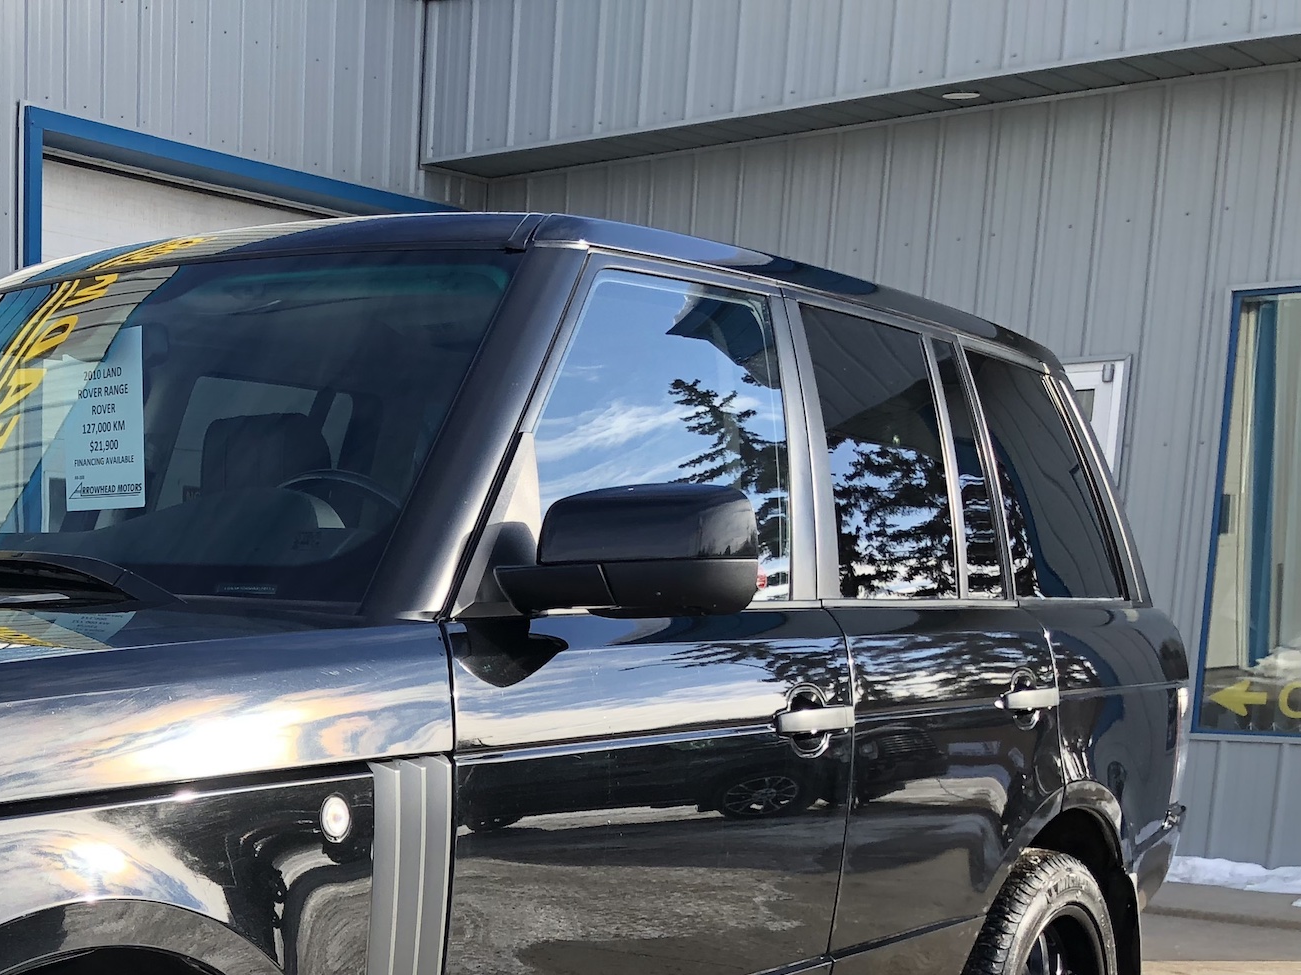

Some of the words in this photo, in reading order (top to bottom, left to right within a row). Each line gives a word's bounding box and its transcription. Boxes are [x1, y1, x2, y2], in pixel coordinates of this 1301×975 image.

[83, 369, 102, 381] 2010
[103, 366, 122, 379] LAND
[77, 387, 103, 399] ROVER
[104, 383, 129, 396] RANGE
[91, 403, 116, 415] ROVER
[82, 421, 111, 435] 127,000
[112, 419, 126, 431] KM
[89, 439, 119, 453] $21,900
[74, 457, 105, 467] FINANCING
[105, 454, 135, 465] AVAILABLE
[69, 482, 116, 499] ARROWHEAD
[117, 483, 143, 493] MOTORS
